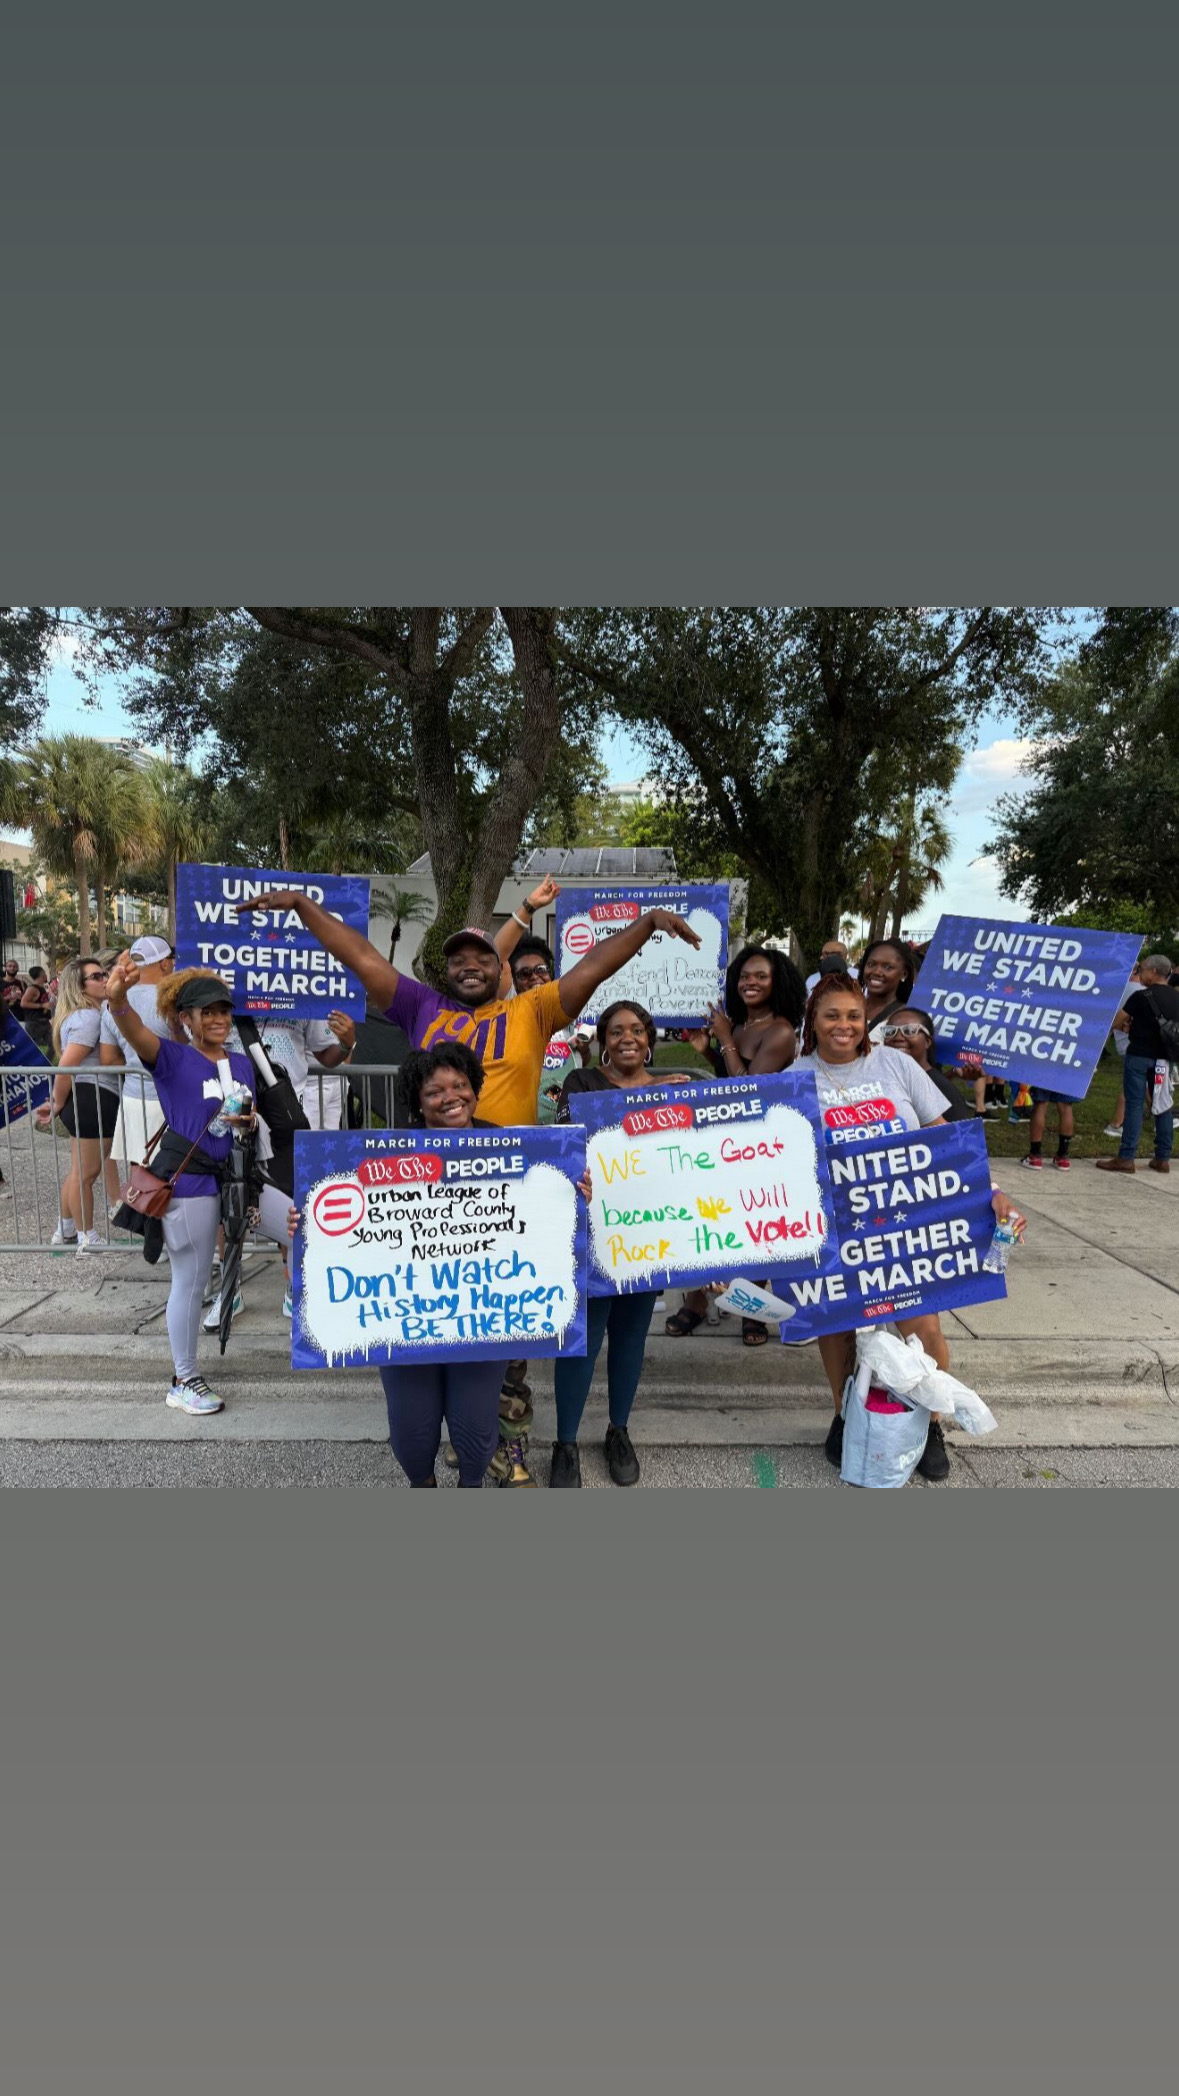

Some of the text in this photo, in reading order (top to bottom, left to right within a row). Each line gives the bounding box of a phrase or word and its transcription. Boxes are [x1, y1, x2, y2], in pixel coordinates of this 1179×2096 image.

[648, 891, 687, 899] FREEDOM
[194, 901, 239, 925] WE
[594, 905, 612, 919] We
[613, 903, 635, 918] The
[197, 943, 345, 972] TOGETHER
[974, 929, 1082, 961] UNITED
[213, 969, 355, 998] E MARCH.
[942, 949, 1100, 995] WE STAND.
[271, 1002, 296, 1010] PEOPLE
[931, 988, 1082, 1037] TOGETHER
[964, 1021, 1081, 1068] MARCH.
[982, 1058, 1009, 1068] PEOPLE
[626, 1083, 758, 1104] MARCH FOR FREEDOM
[822, 1081, 882, 1101] MARCH
[628, 1099, 763, 1135] We The PEOPLE
[829, 1103, 890, 1128] We The
[365, 1137, 521, 1149] MARCH FOR FREEDOM
[831, 1119, 904, 1144] PEOPLE
[364, 1155, 523, 1183] We The PEOPLE
[597, 1136, 784, 1185] WE The Goat
[830, 1143, 932, 1185] NITED
[488, 1184, 511, 1200] of
[602, 1199, 694, 1227] because
[740, 1183, 788, 1212] Will
[848, 1169, 970, 1214] STAND.
[367, 1201, 516, 1223] Broward County
[688, 1224, 743, 1254] the
[840, 1218, 973, 1267] GETHER
[327, 1250, 537, 1303] Don't Watch
[789, 1273, 847, 1308] WE
[356, 1293, 460, 1328] History
[894, 1296, 922, 1311] PEOPLE
[400, 1304, 555, 1341] BE THERE!
